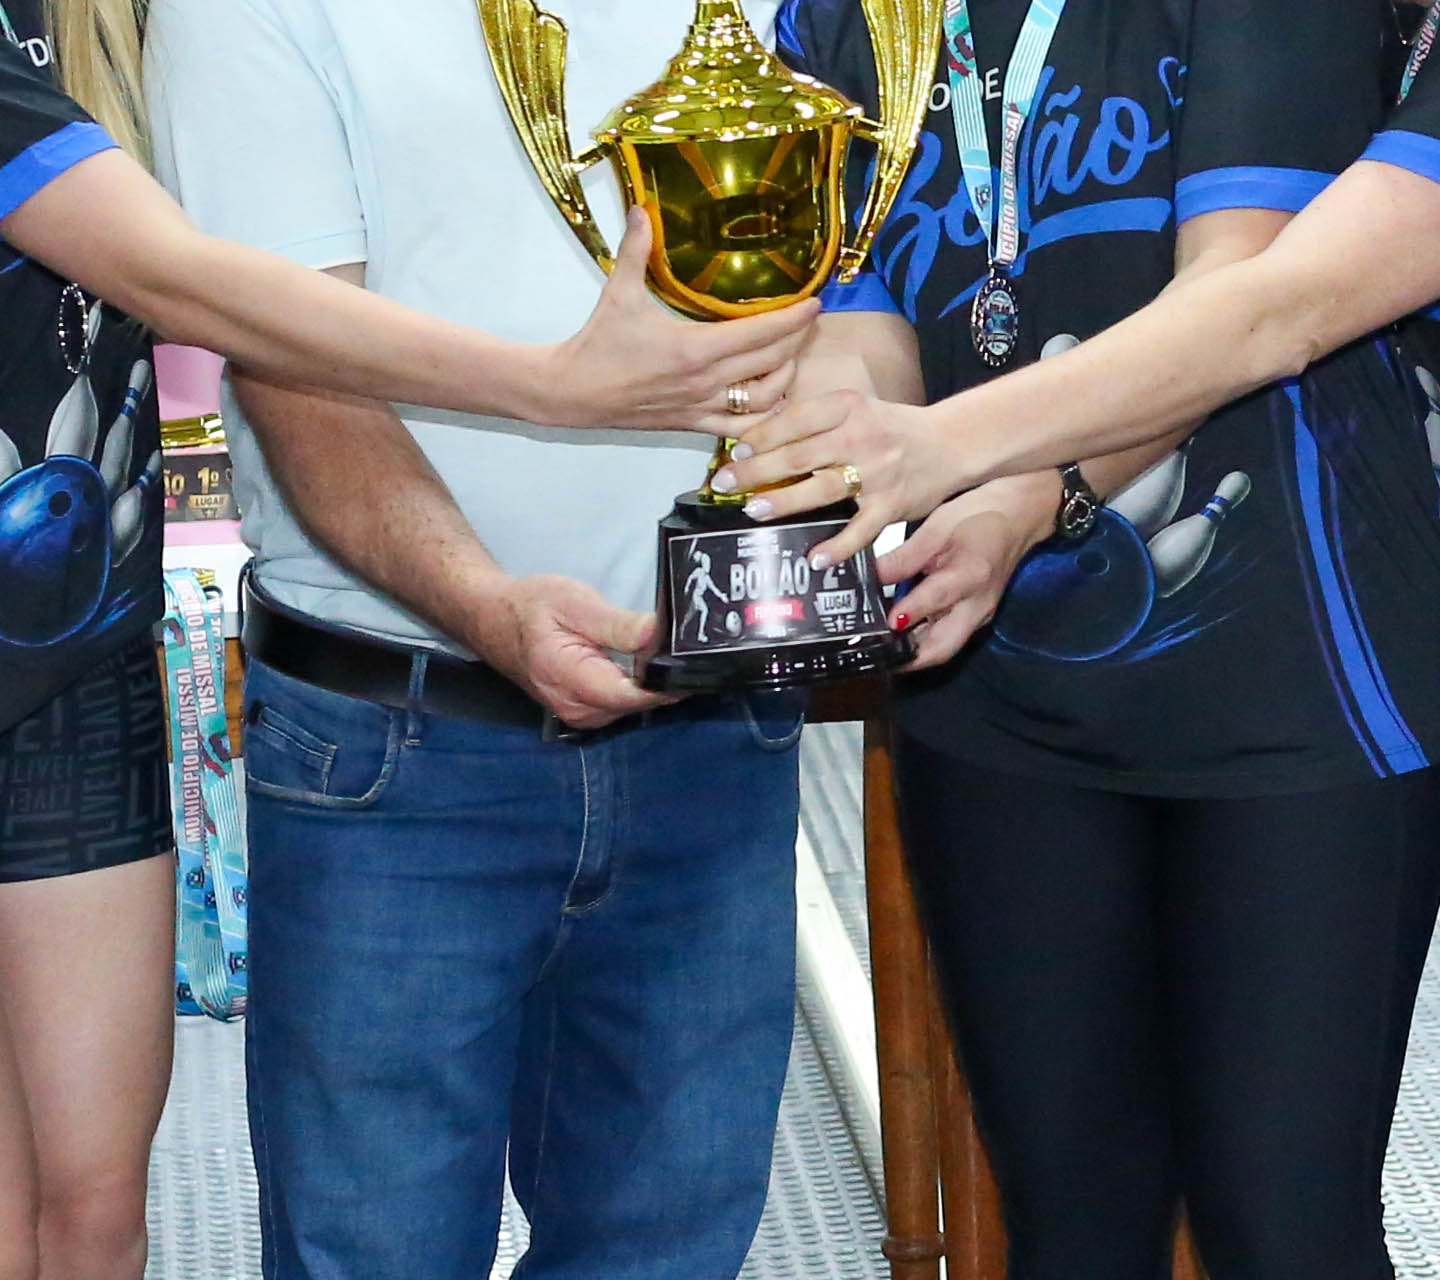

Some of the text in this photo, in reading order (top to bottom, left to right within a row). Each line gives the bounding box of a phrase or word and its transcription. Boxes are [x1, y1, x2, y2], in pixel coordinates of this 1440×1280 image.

[198, 466, 220, 494] 1º
[823, 593, 853, 611] LUGAR
[192, 653, 219, 718] MISSAL
[181, 729, 200, 752] DE
[183, 754, 202, 845] MUNICÍPIO
